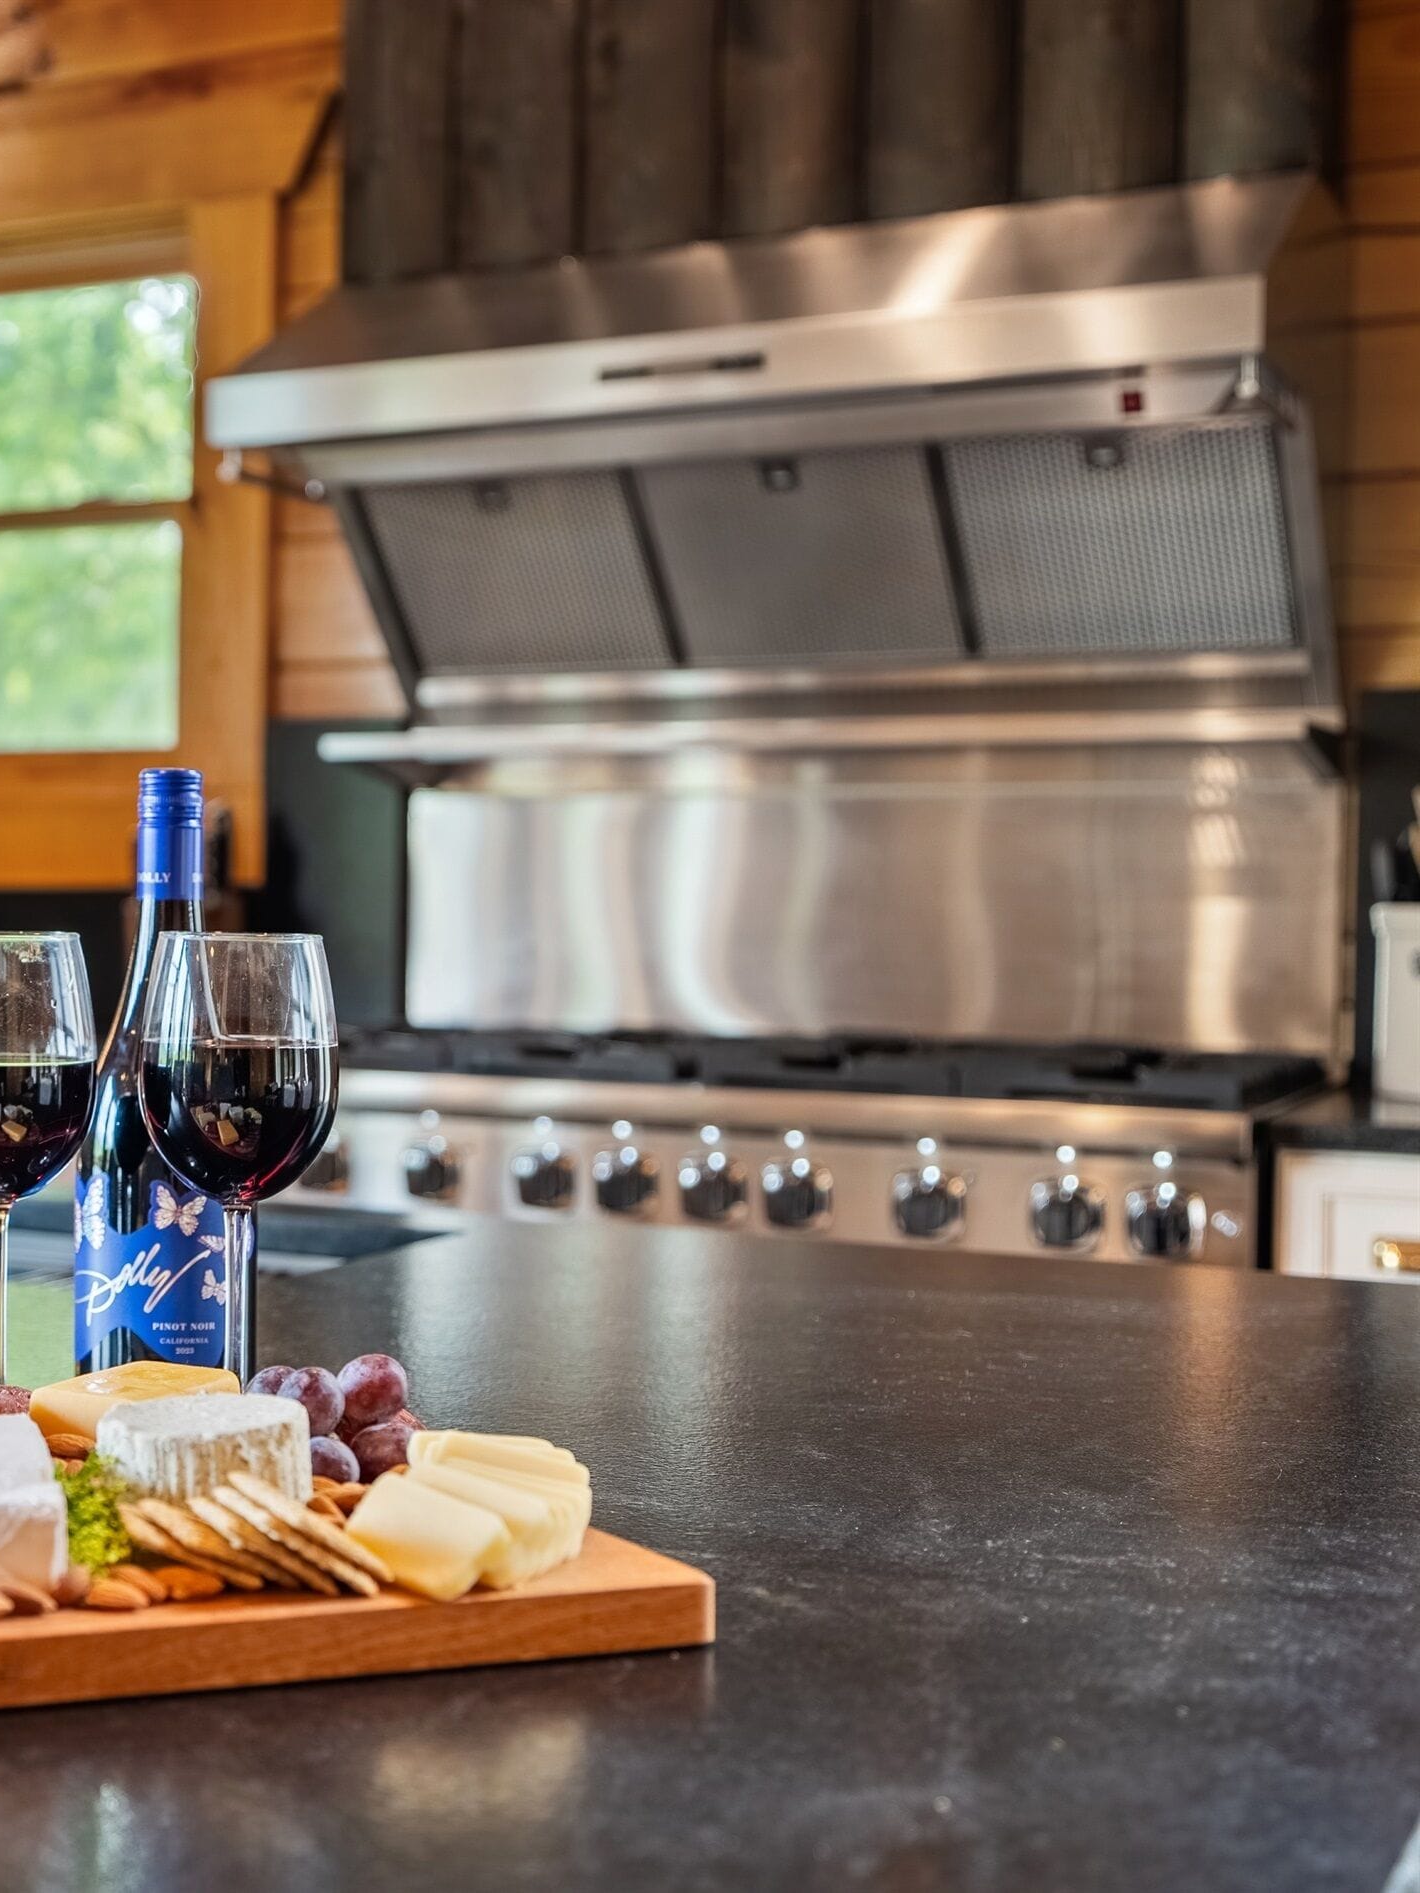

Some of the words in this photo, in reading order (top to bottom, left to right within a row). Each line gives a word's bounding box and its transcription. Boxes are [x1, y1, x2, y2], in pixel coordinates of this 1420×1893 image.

[75, 1243, 212, 1327] Dolly
[152, 1322, 187, 1331] PINOT
[190, 1321, 216, 1331] NOIR
[159, 1337, 209, 1345] CALIFORNIA
